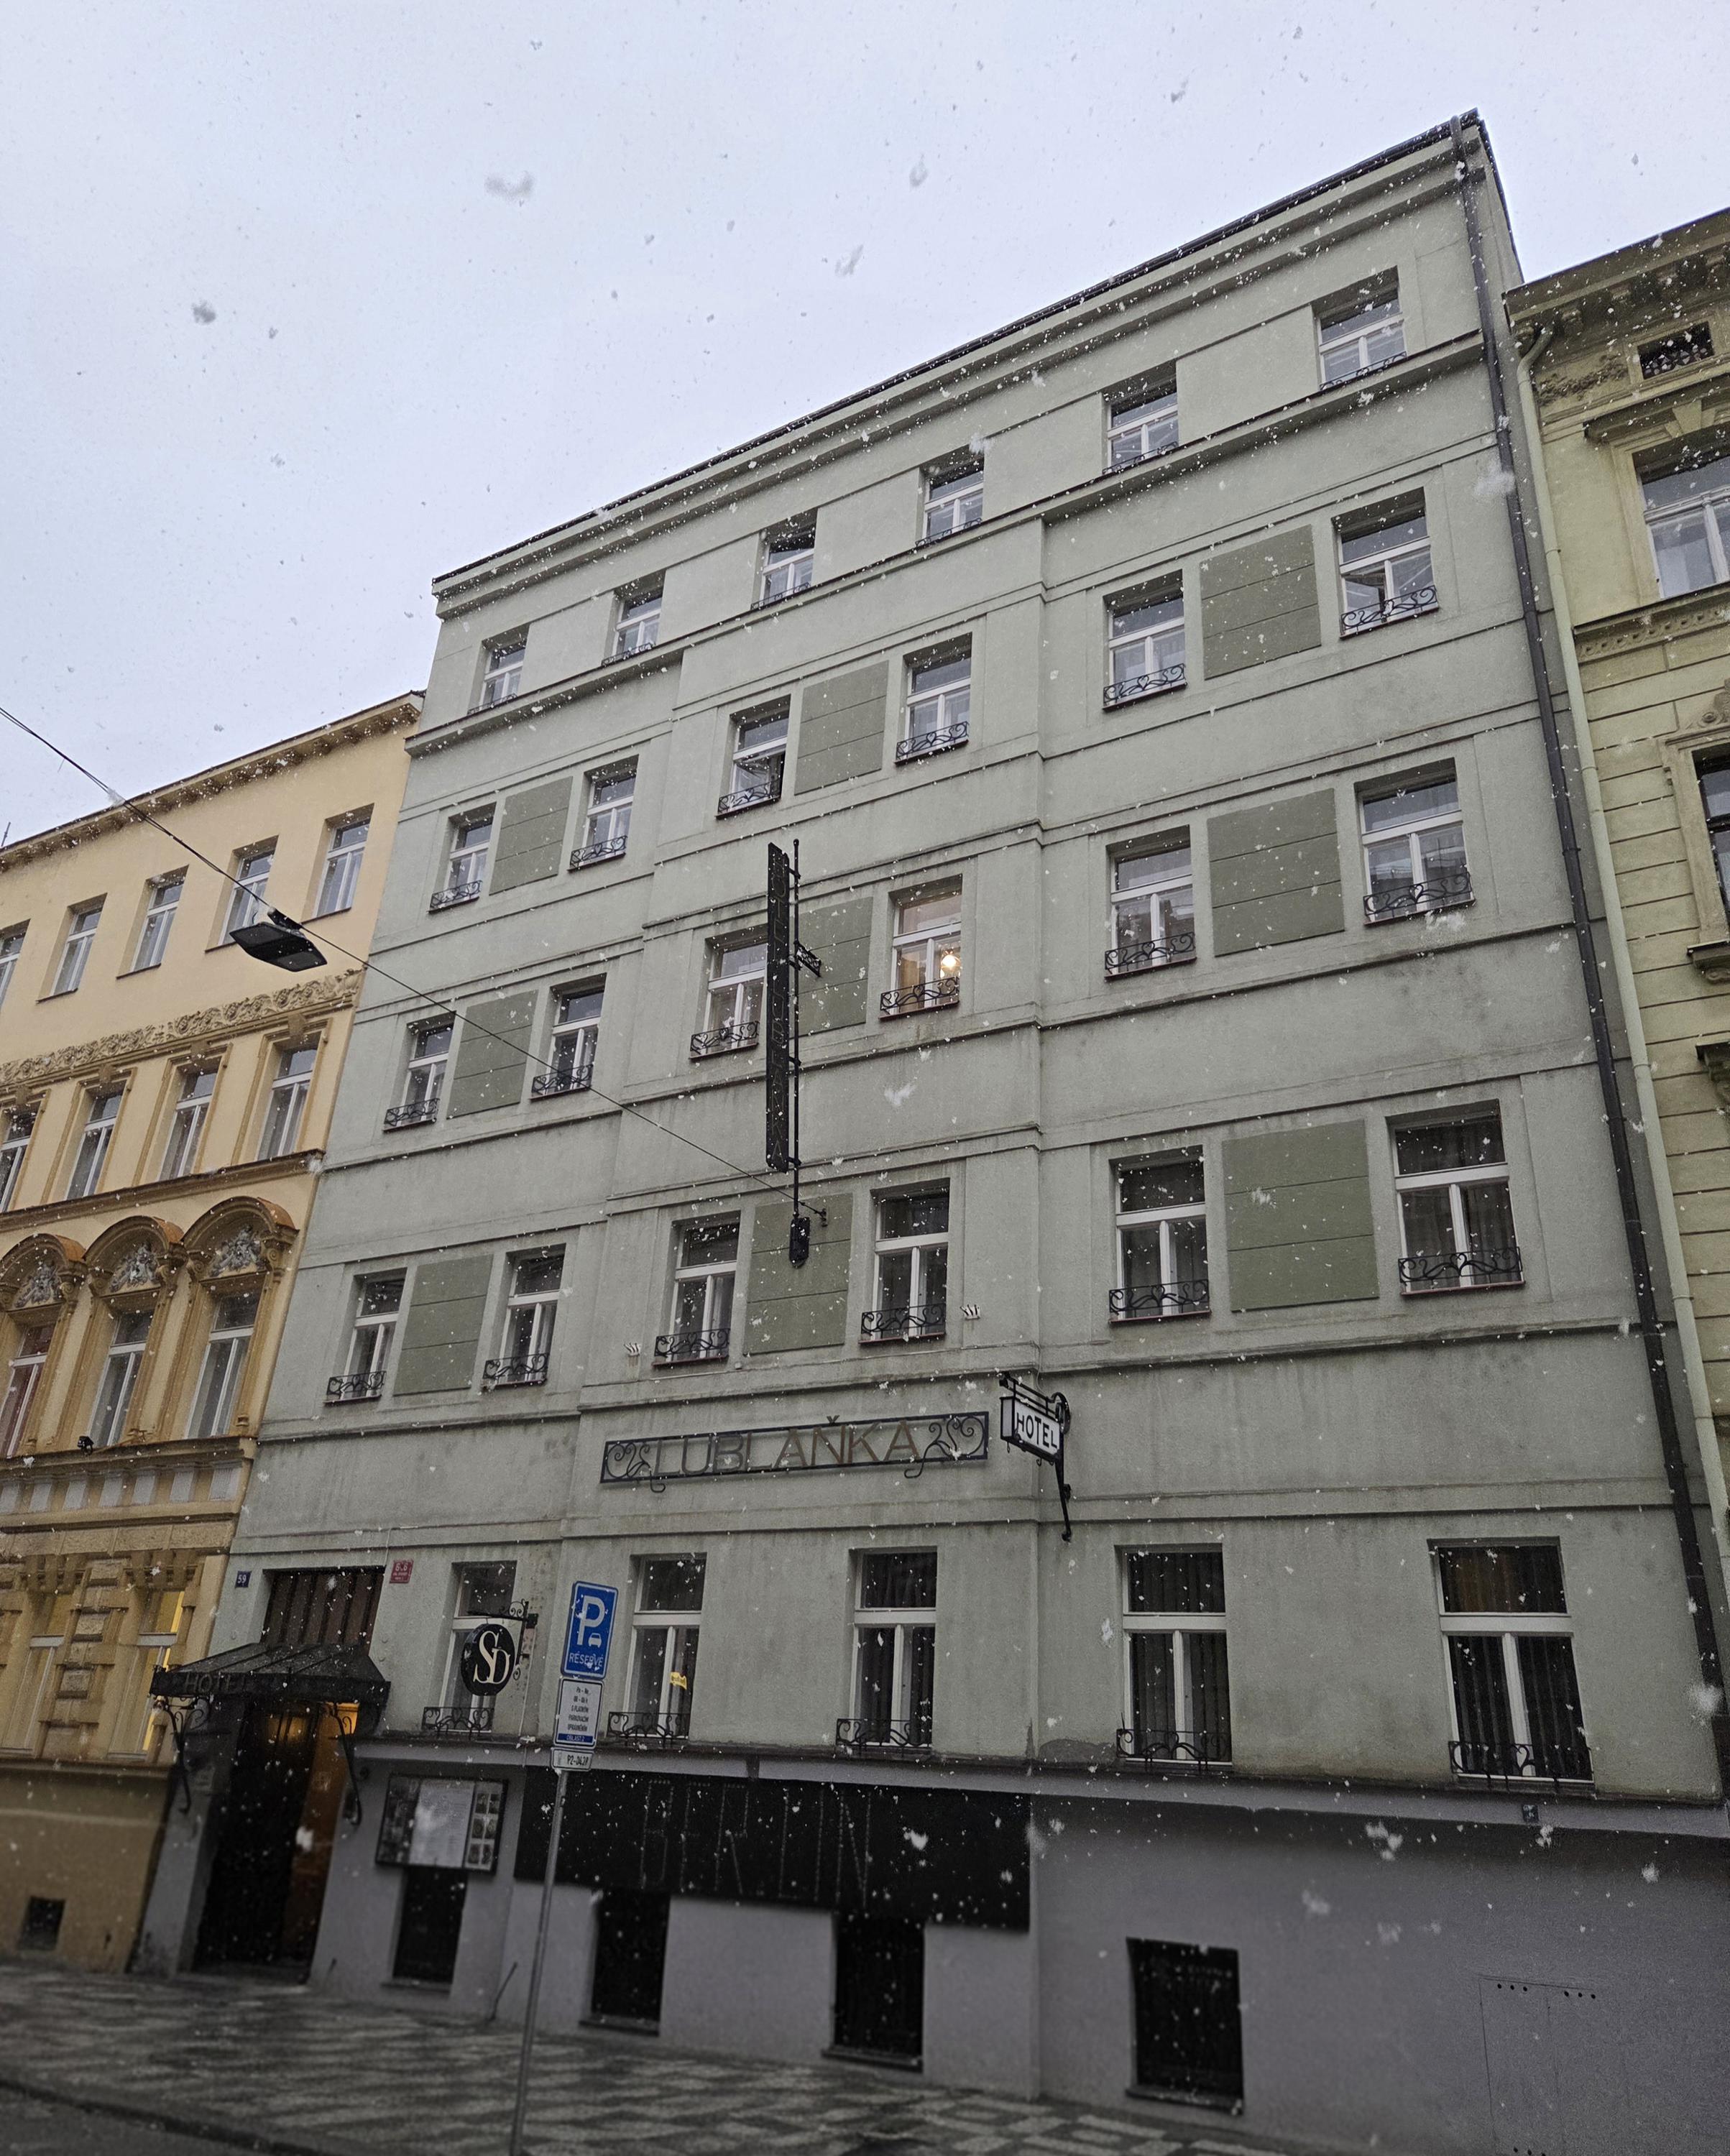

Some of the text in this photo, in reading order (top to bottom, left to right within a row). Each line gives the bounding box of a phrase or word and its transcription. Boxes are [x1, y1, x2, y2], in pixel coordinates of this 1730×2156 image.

[653, 1414, 920, 1476] LUBLAŇKA
[1016, 1411, 1058, 1449] HOTEL
[237, 1574, 247, 1584] 59
[576, 1595, 606, 1646] P
